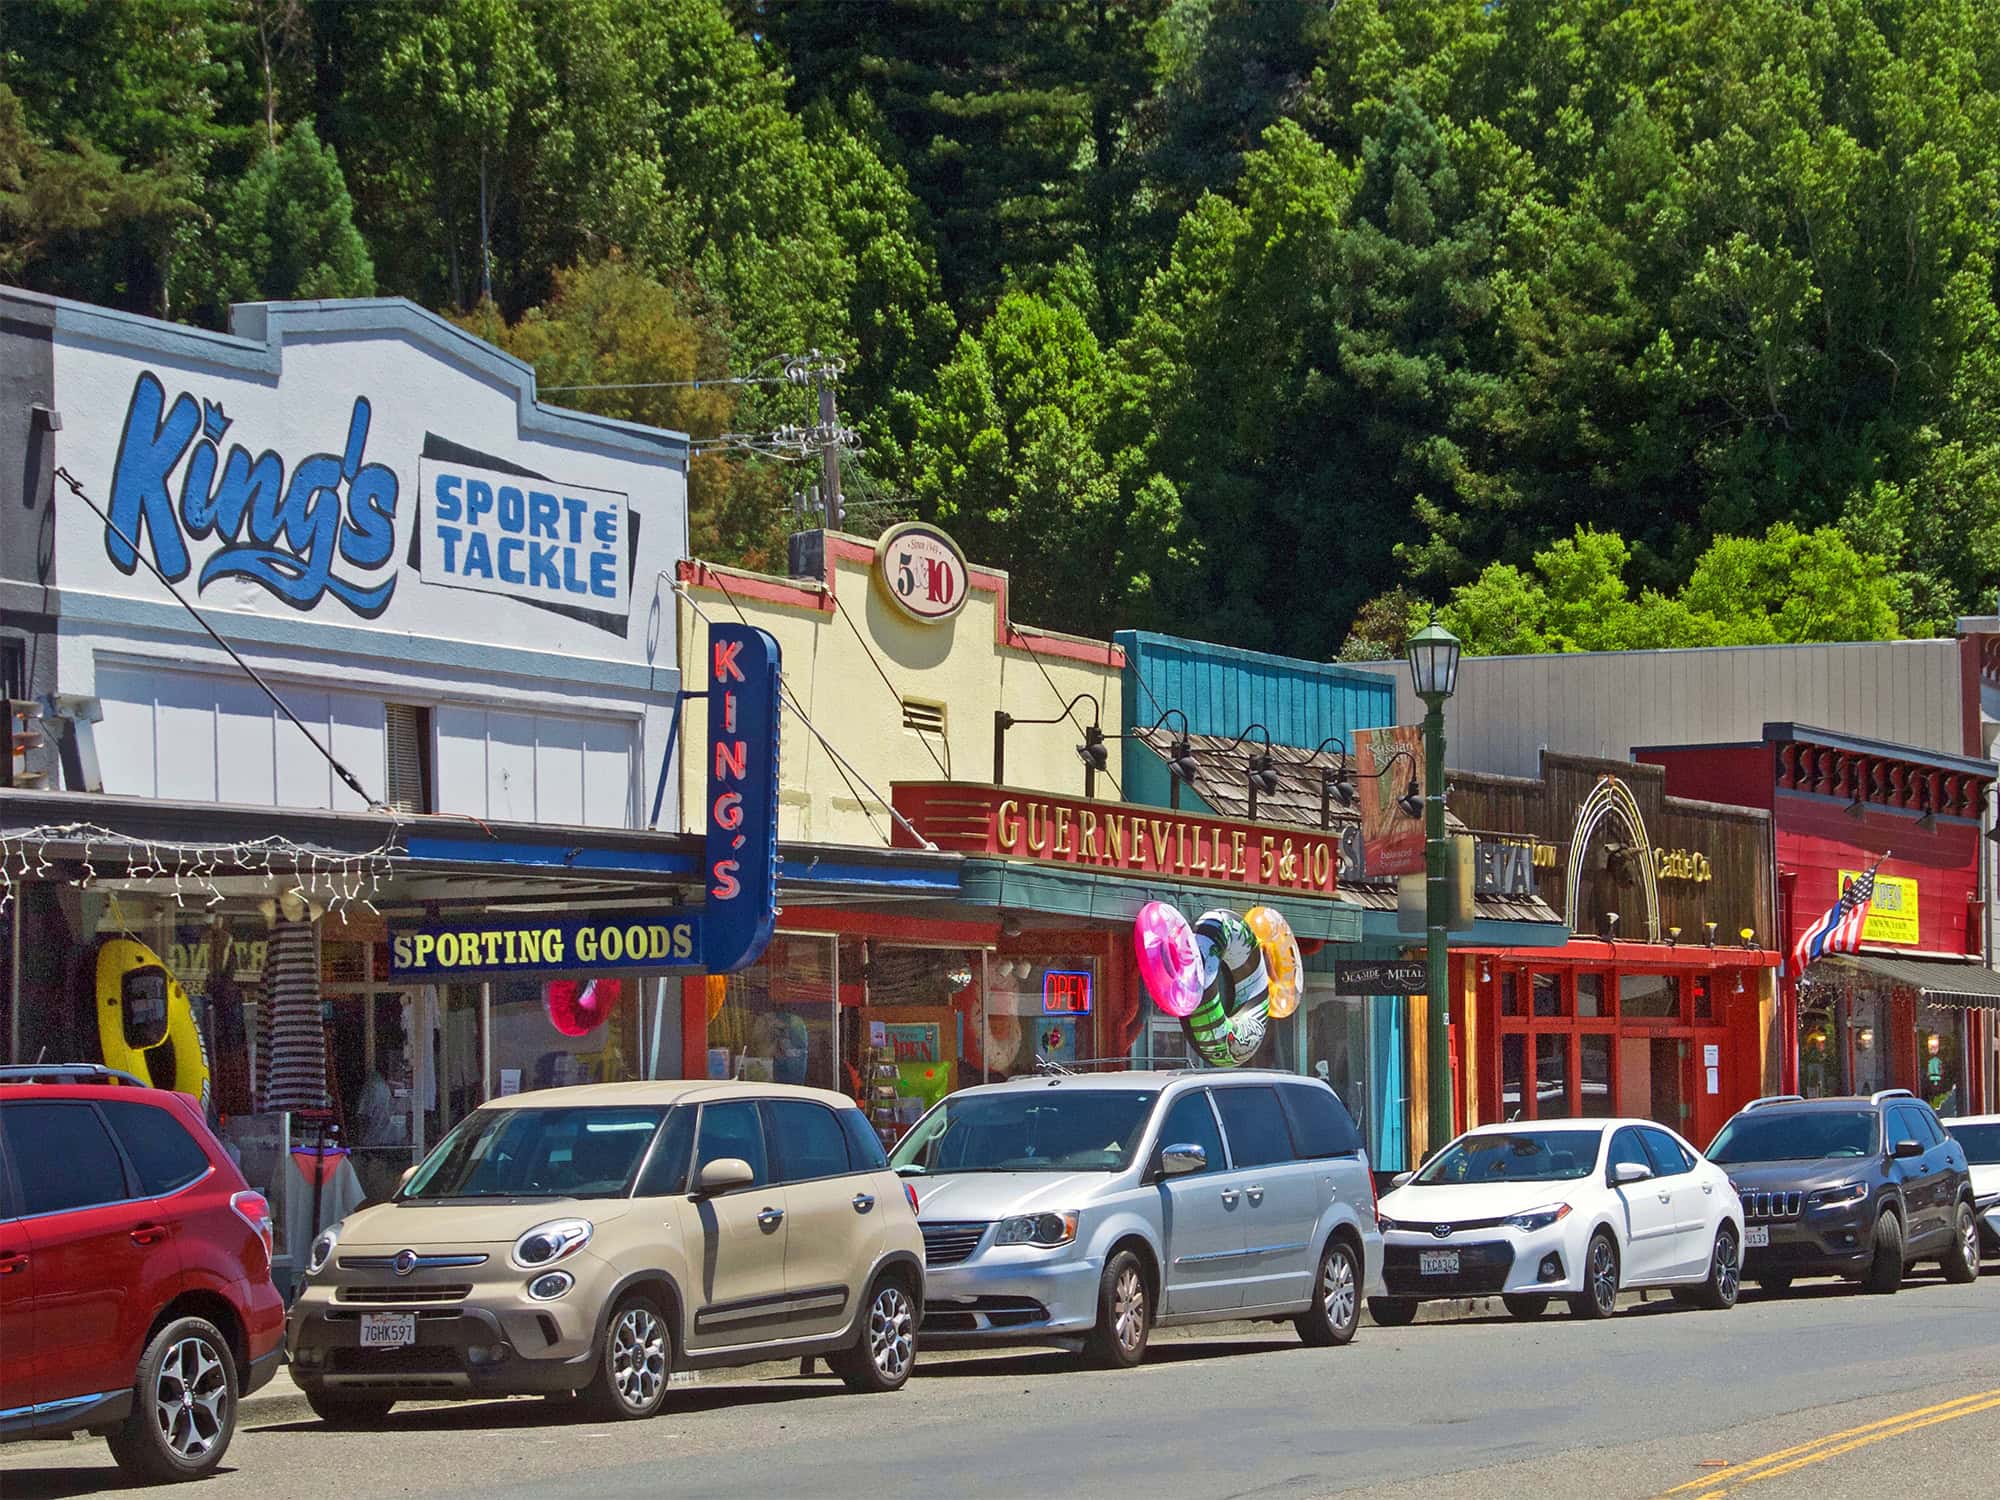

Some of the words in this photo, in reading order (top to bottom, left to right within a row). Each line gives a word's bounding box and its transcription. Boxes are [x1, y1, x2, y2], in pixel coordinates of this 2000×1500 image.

[104, 370, 399, 620] King's
[436, 474, 587, 544] SPORT
[437, 525, 617, 599] TACKLE
[711, 639, 747, 900] KING'S
[998, 800, 1247, 875] GUERNEVILLE
[393, 928, 564, 969] SPORTING
[575, 924, 693, 962] GOODS
[1045, 973, 1089, 1011] OPEN
[363, 1325, 412, 1342] 7GHK597
